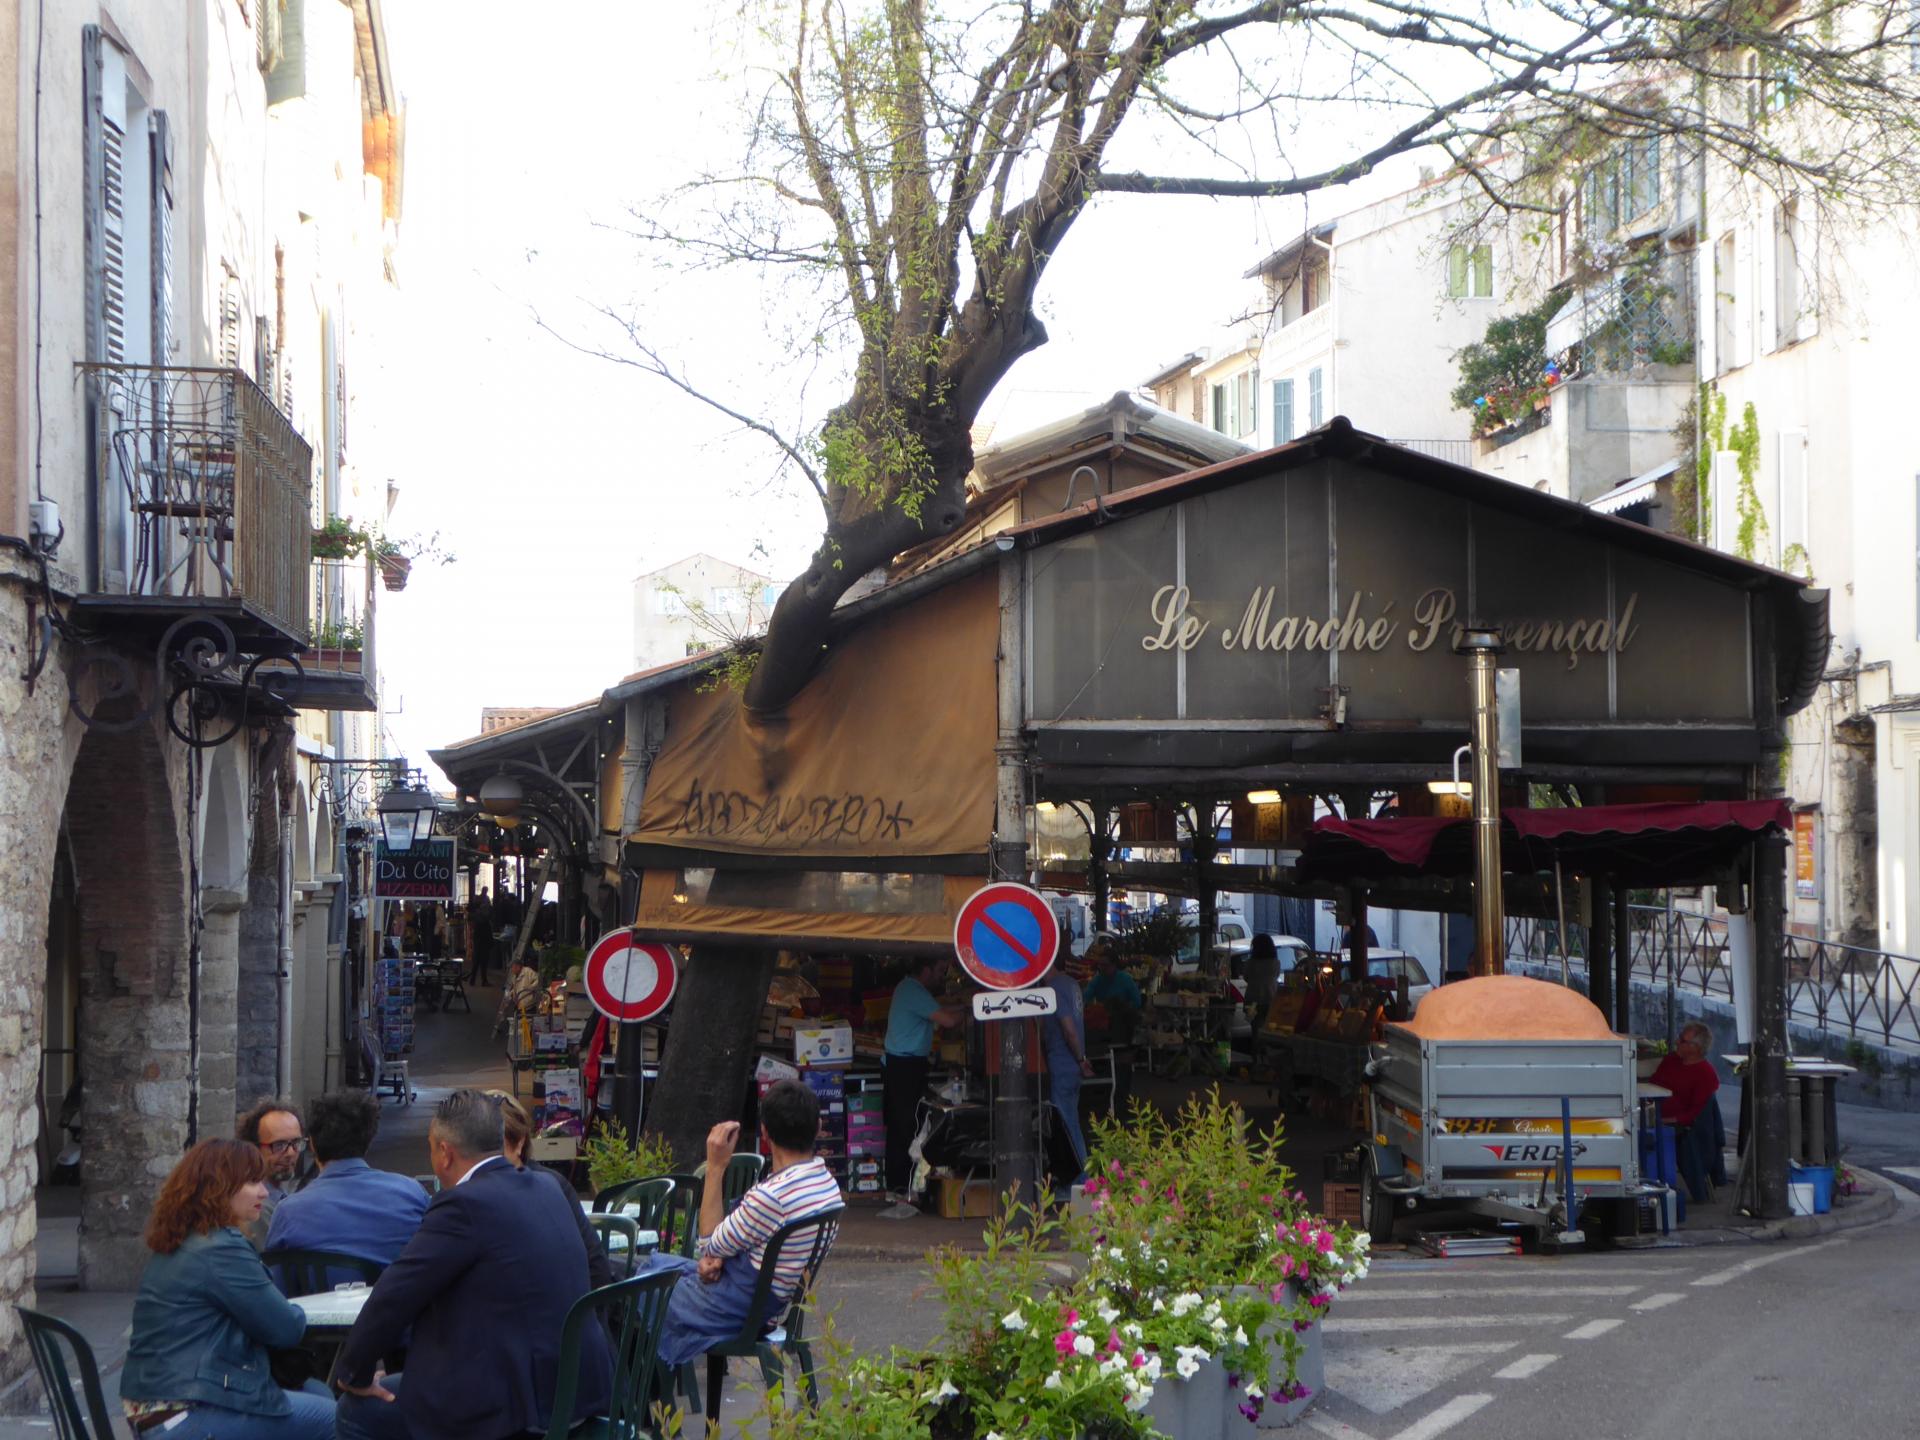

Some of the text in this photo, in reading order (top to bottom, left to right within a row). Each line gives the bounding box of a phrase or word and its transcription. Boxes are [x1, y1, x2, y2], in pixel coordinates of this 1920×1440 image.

[1142, 584, 1639, 671] Le Marché Prvençal
[377, 860, 450, 880] Du Cito
[377, 882, 450, 897] PIZZERIA
[1512, 1118, 1554, 1134] Classic
